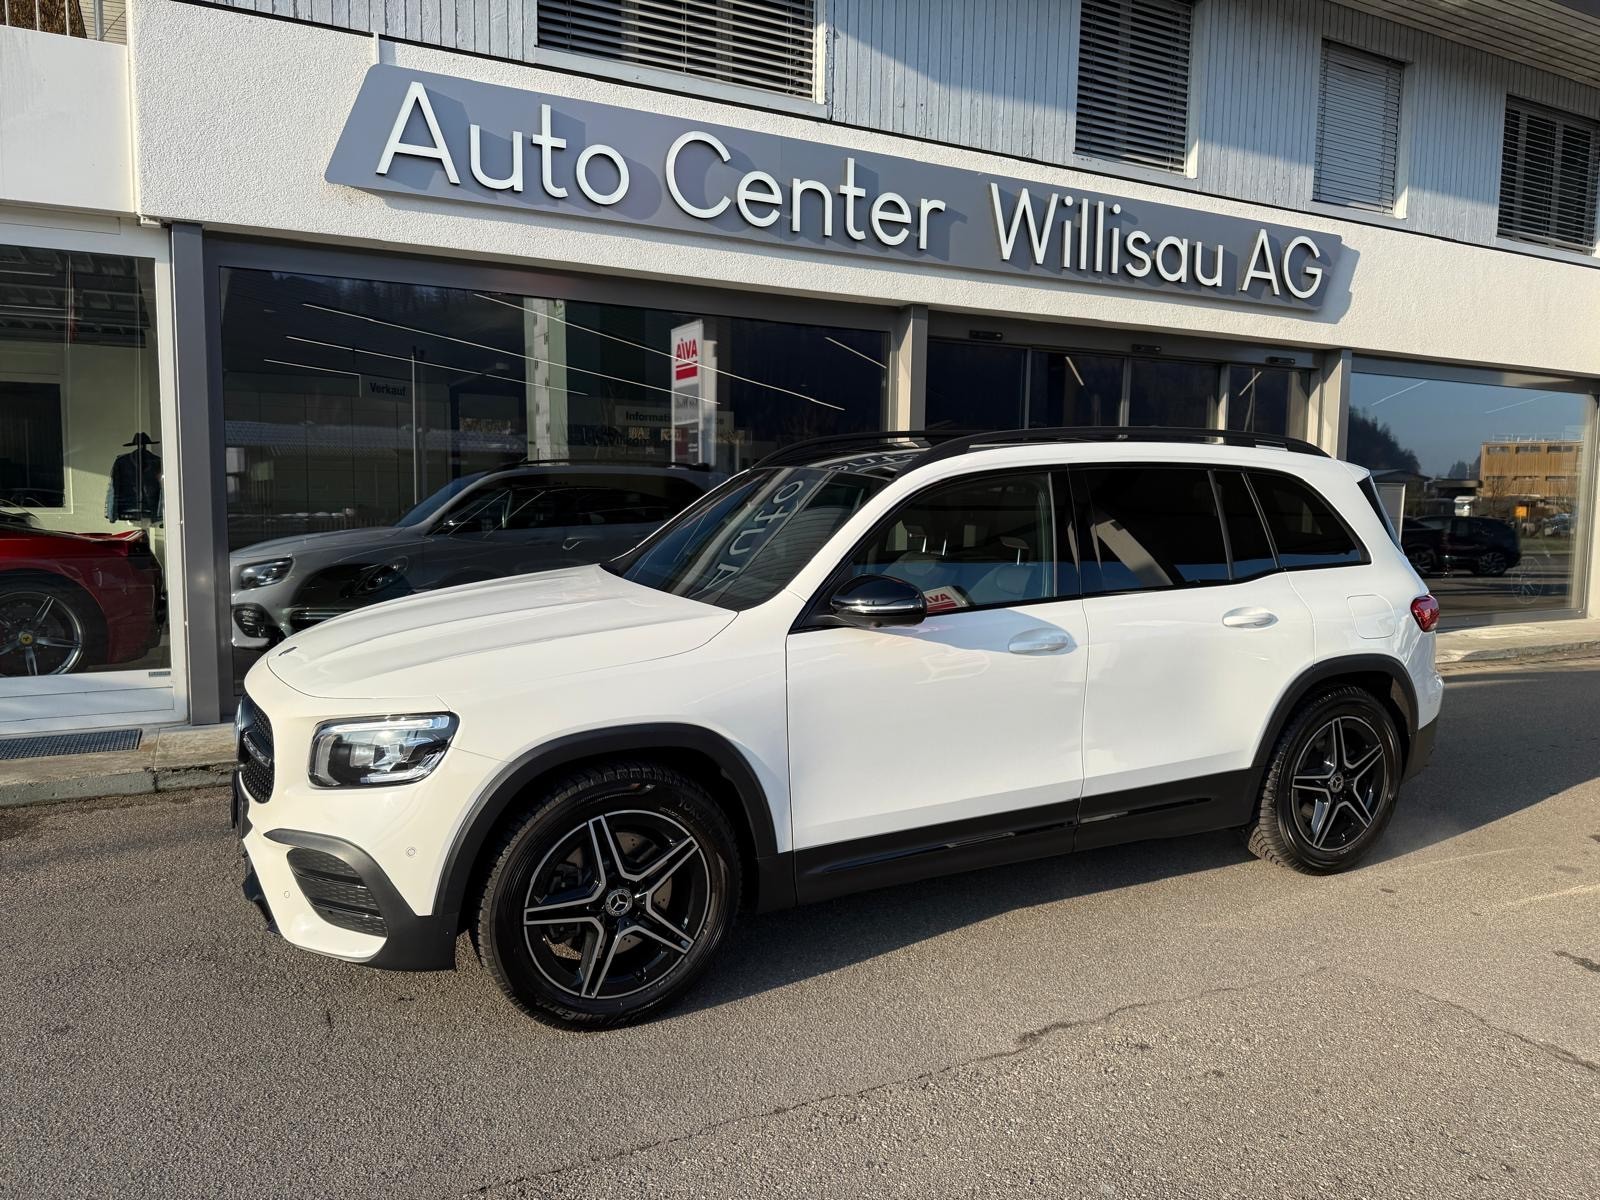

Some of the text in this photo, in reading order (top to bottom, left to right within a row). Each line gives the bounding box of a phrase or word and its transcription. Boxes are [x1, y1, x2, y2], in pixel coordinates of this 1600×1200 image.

[376, 81, 1323, 299] Auto Center Willisau AG
[369, 382, 406, 396] Verkauf
